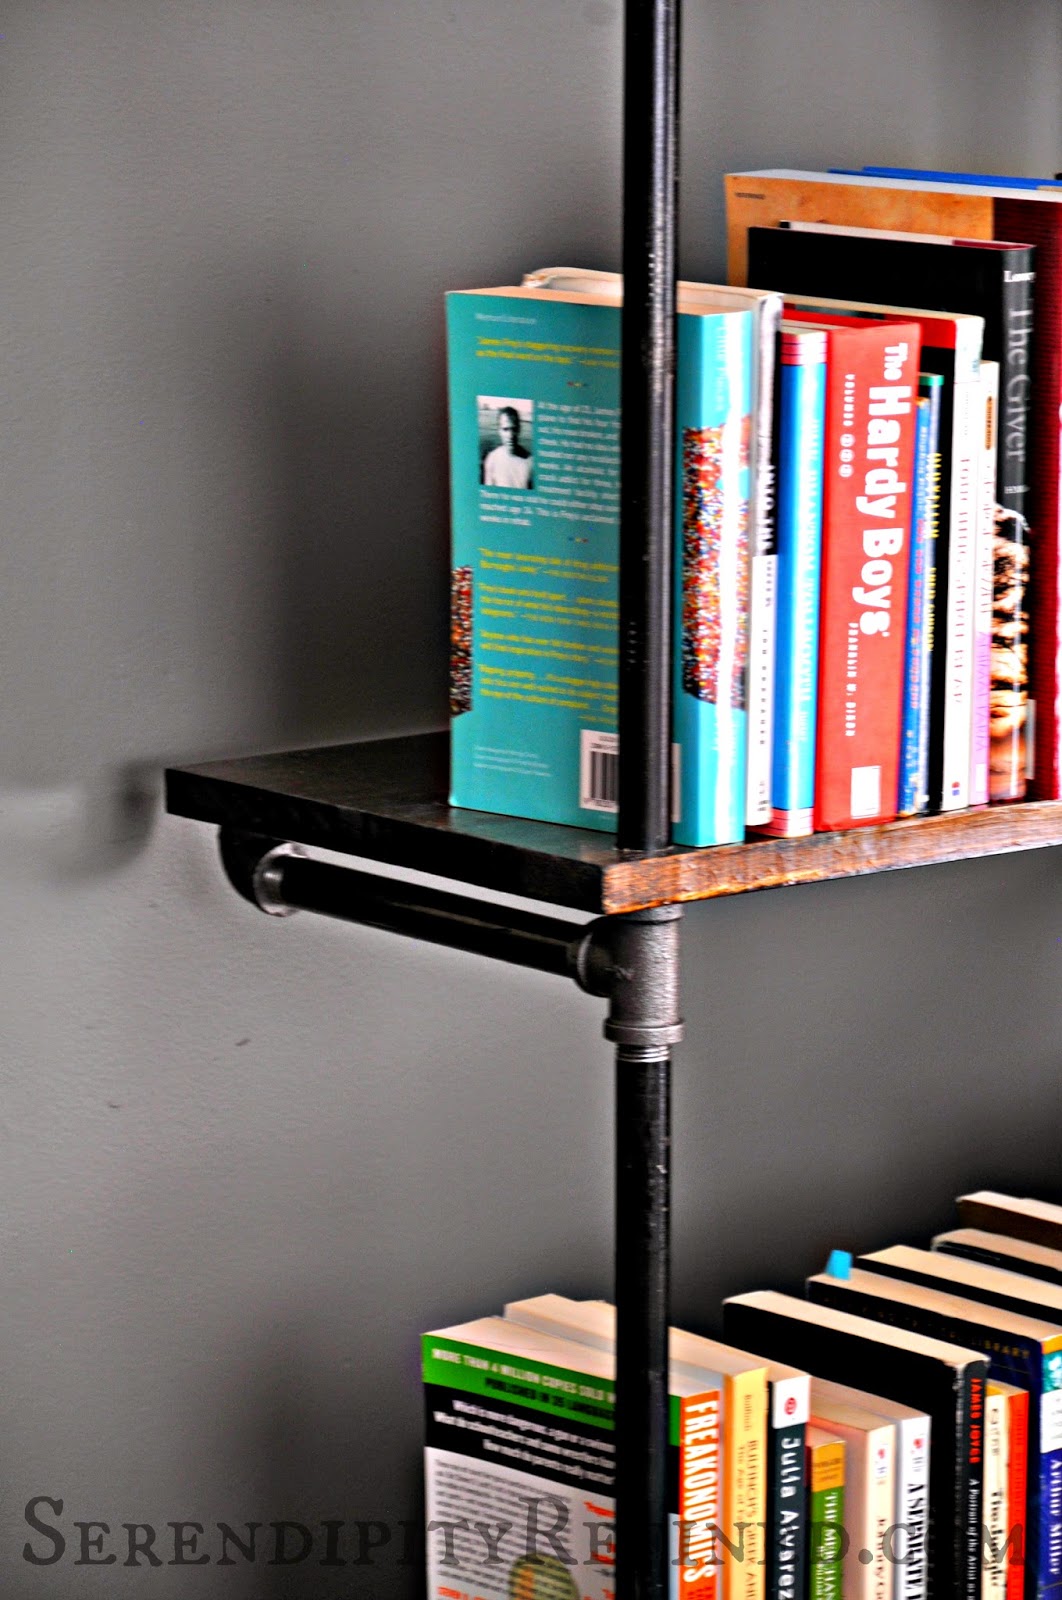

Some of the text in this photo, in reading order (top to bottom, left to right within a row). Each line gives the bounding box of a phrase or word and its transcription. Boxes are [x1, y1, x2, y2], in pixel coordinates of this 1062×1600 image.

[884, 342, 908, 381] The
[1007, 309, 1033, 366] The
[856, 385, 911, 519] Hardy
[1005, 373, 1032, 462] Giver
[969, 1378, 982, 1419] JAMES
[968, 1424, 981, 1464] JOYCE
[683, 1400, 719, 1582] FREAKONOMICS
[778, 1437, 800, 1600] Julia Alvarez
[968, 1489, 979, 1523] Portrait
[1049, 1459, 1062, 1575] Arthur Miller
[905, 1497, 926, 1590] SEPARATE
[967, 1555, 978, 1580] Artist
